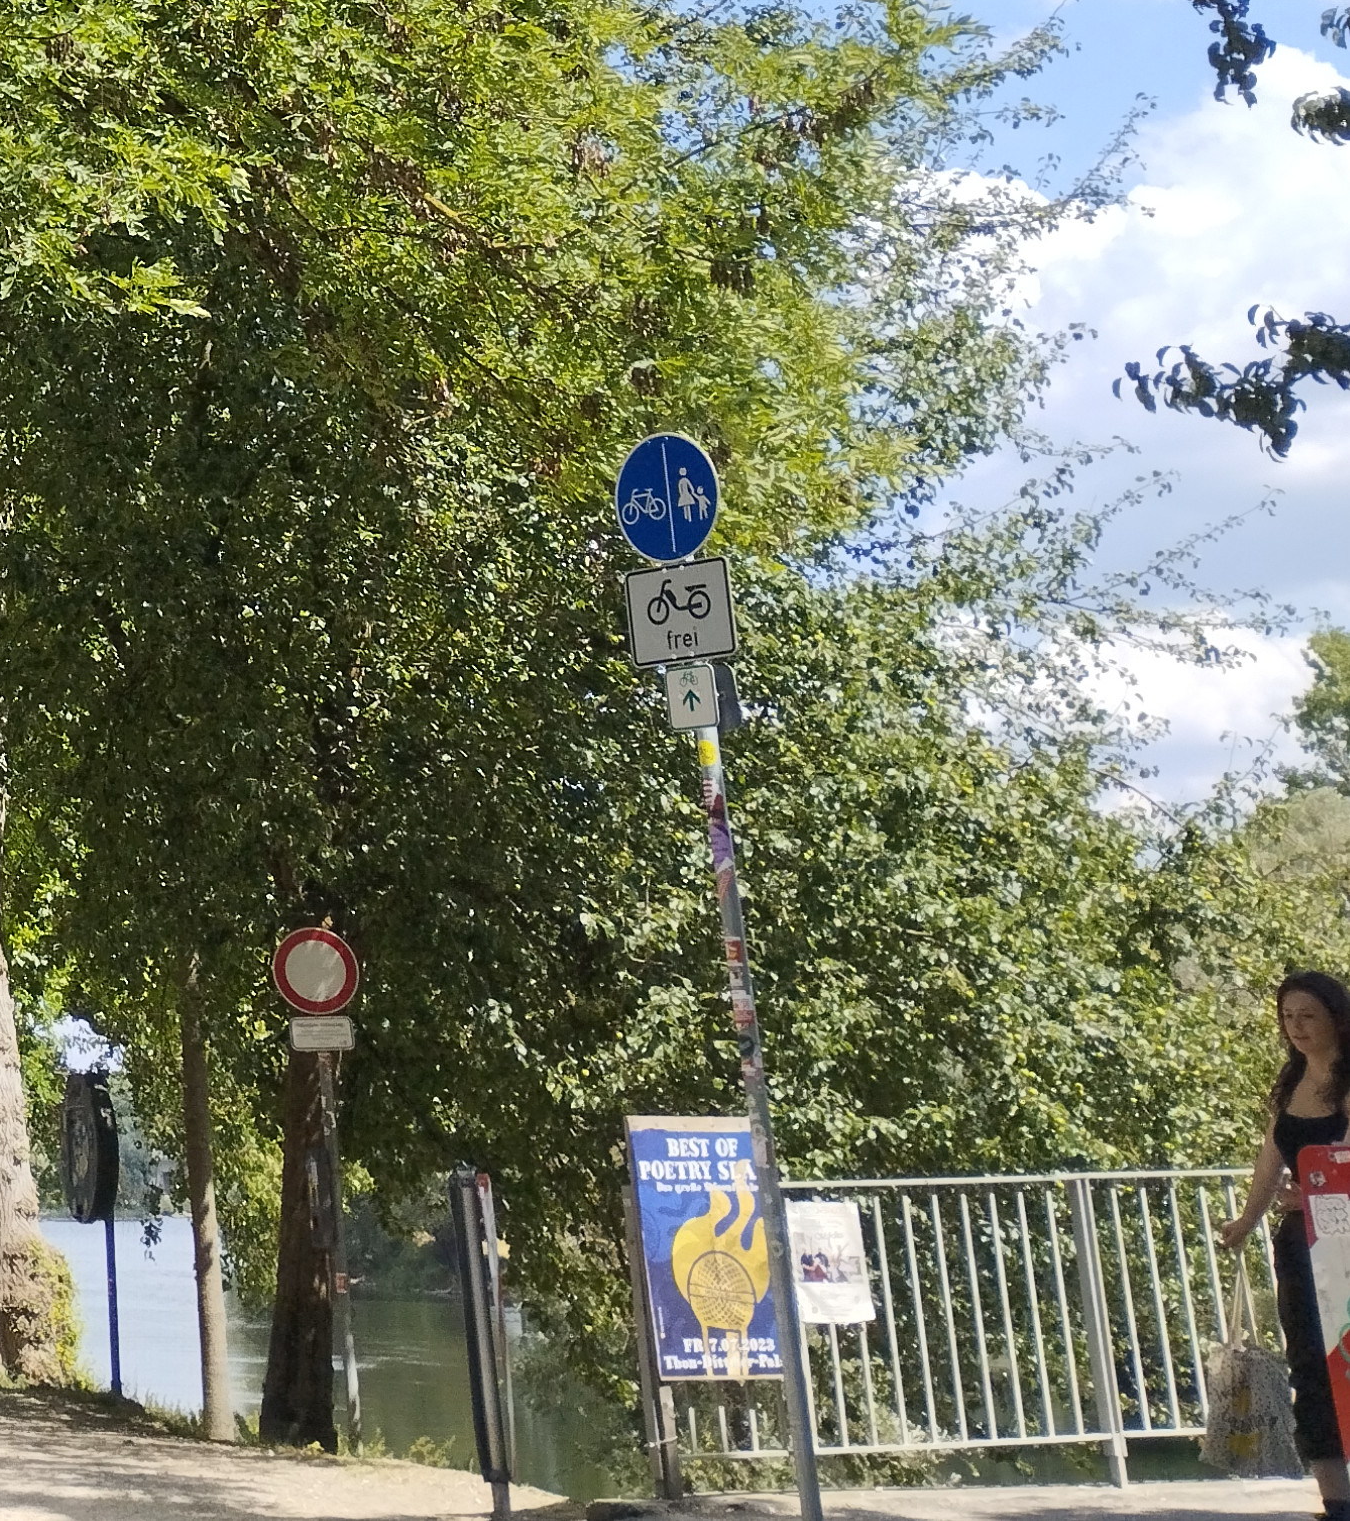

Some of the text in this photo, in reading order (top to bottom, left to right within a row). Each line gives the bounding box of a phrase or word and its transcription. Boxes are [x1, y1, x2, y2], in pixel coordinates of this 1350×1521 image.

[667, 626, 698, 650] frei
[666, 1137, 738, 1158] BEST OF
[638, 1160, 757, 1180] POETRY SLA
